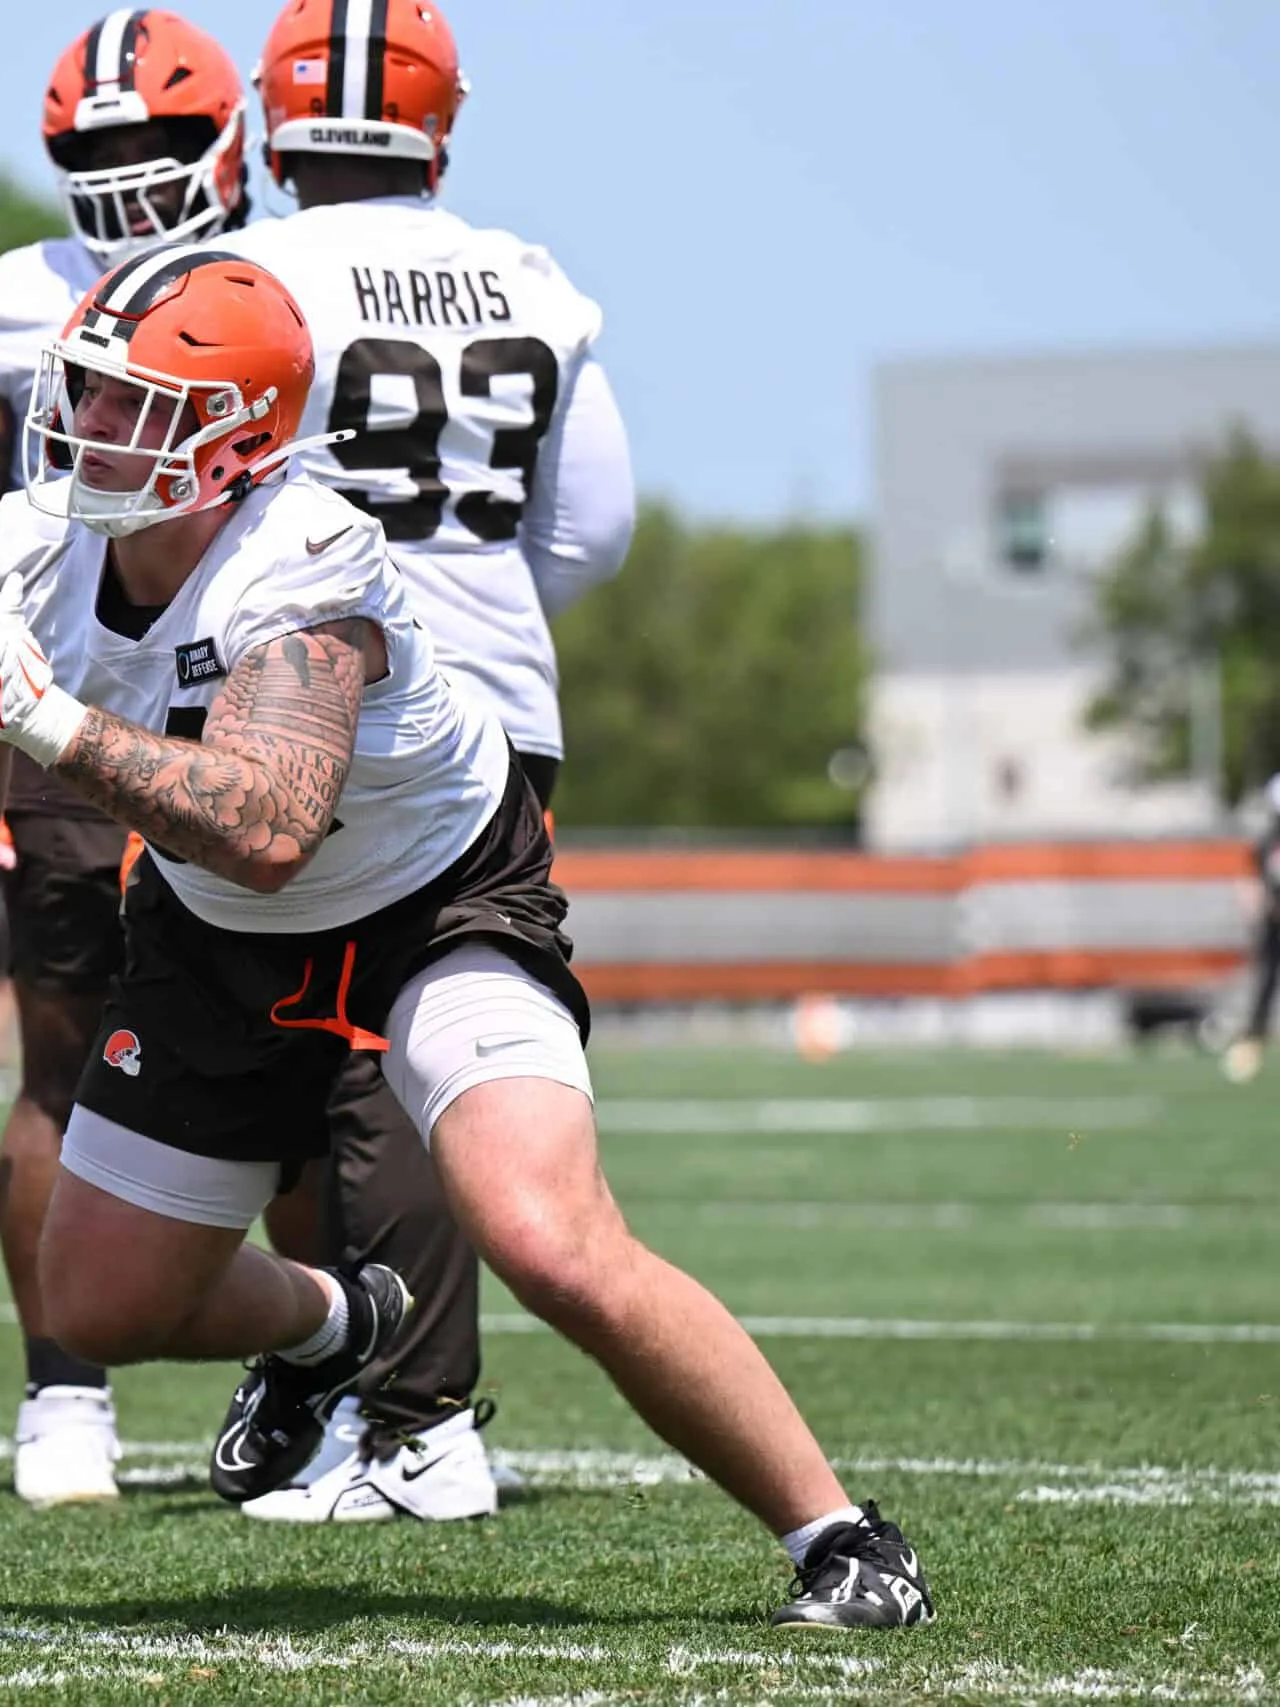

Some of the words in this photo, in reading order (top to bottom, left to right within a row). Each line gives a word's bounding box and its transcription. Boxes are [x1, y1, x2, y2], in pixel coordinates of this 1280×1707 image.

[310, 128, 391, 146] CLEVELAND
[352, 266, 512, 326] HARRIS
[326, 336, 559, 542] 93
